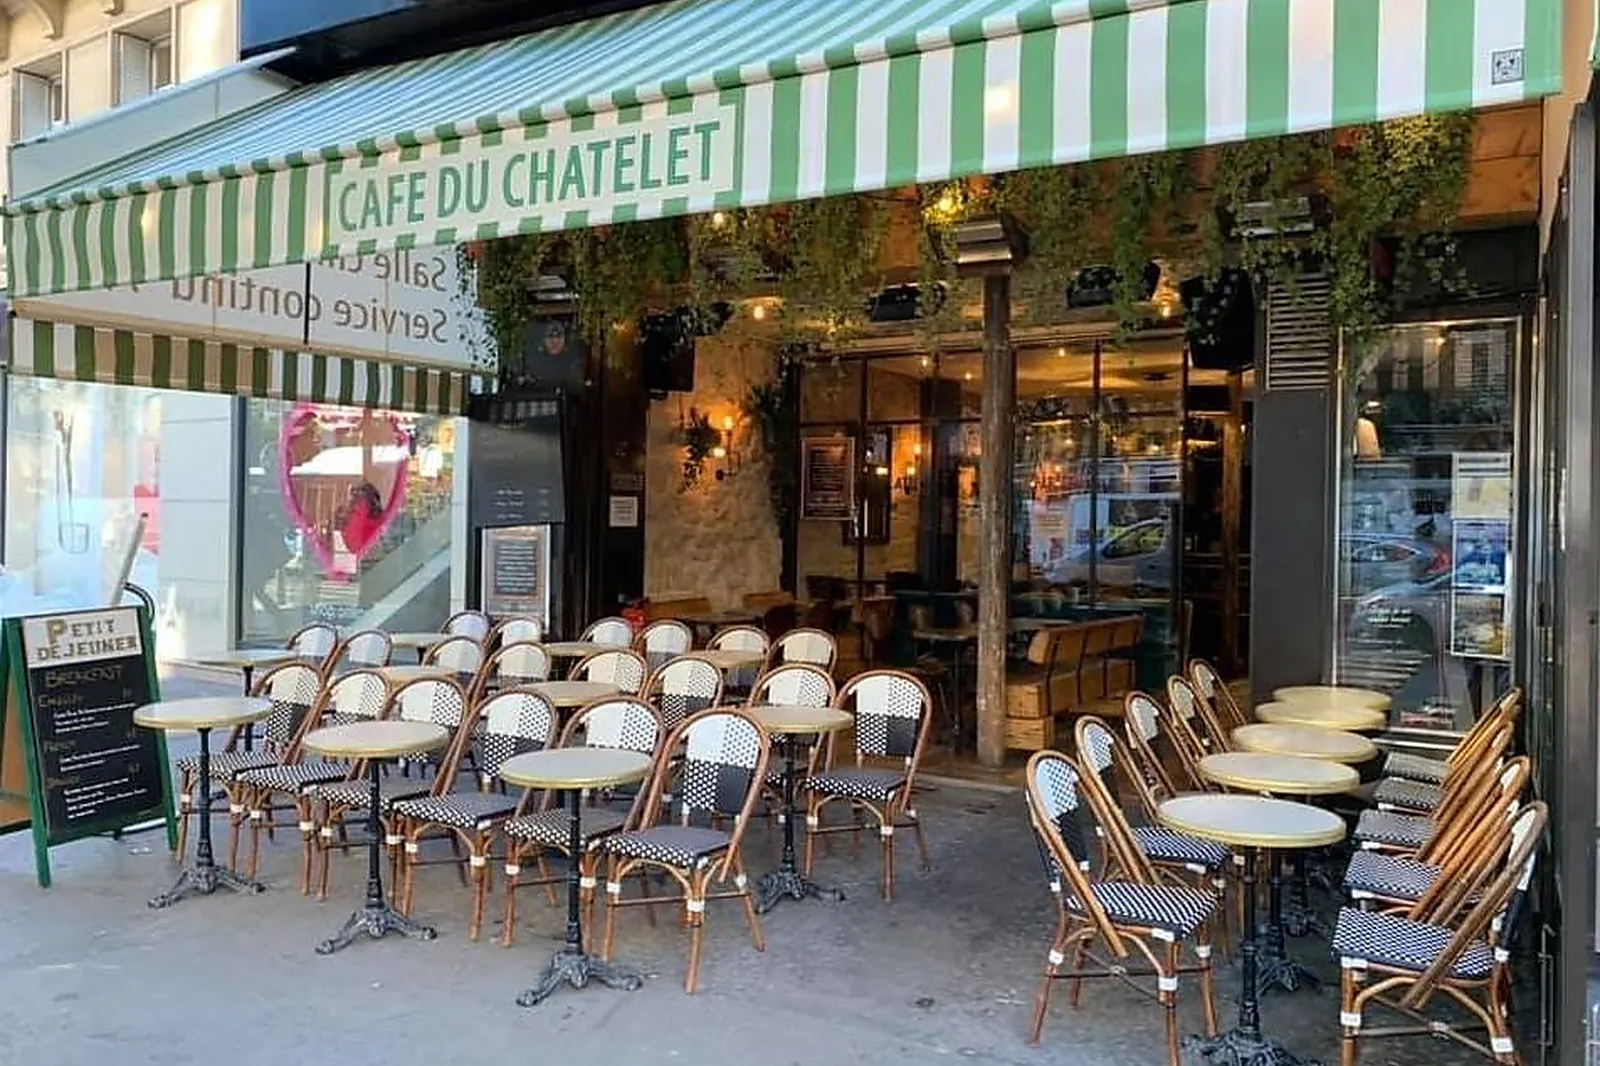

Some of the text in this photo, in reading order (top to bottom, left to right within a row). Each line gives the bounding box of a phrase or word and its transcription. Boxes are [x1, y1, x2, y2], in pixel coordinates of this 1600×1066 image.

[339, 121, 720, 232] CAFE DU CHATELET
[46, 618, 115, 643] PETIT
